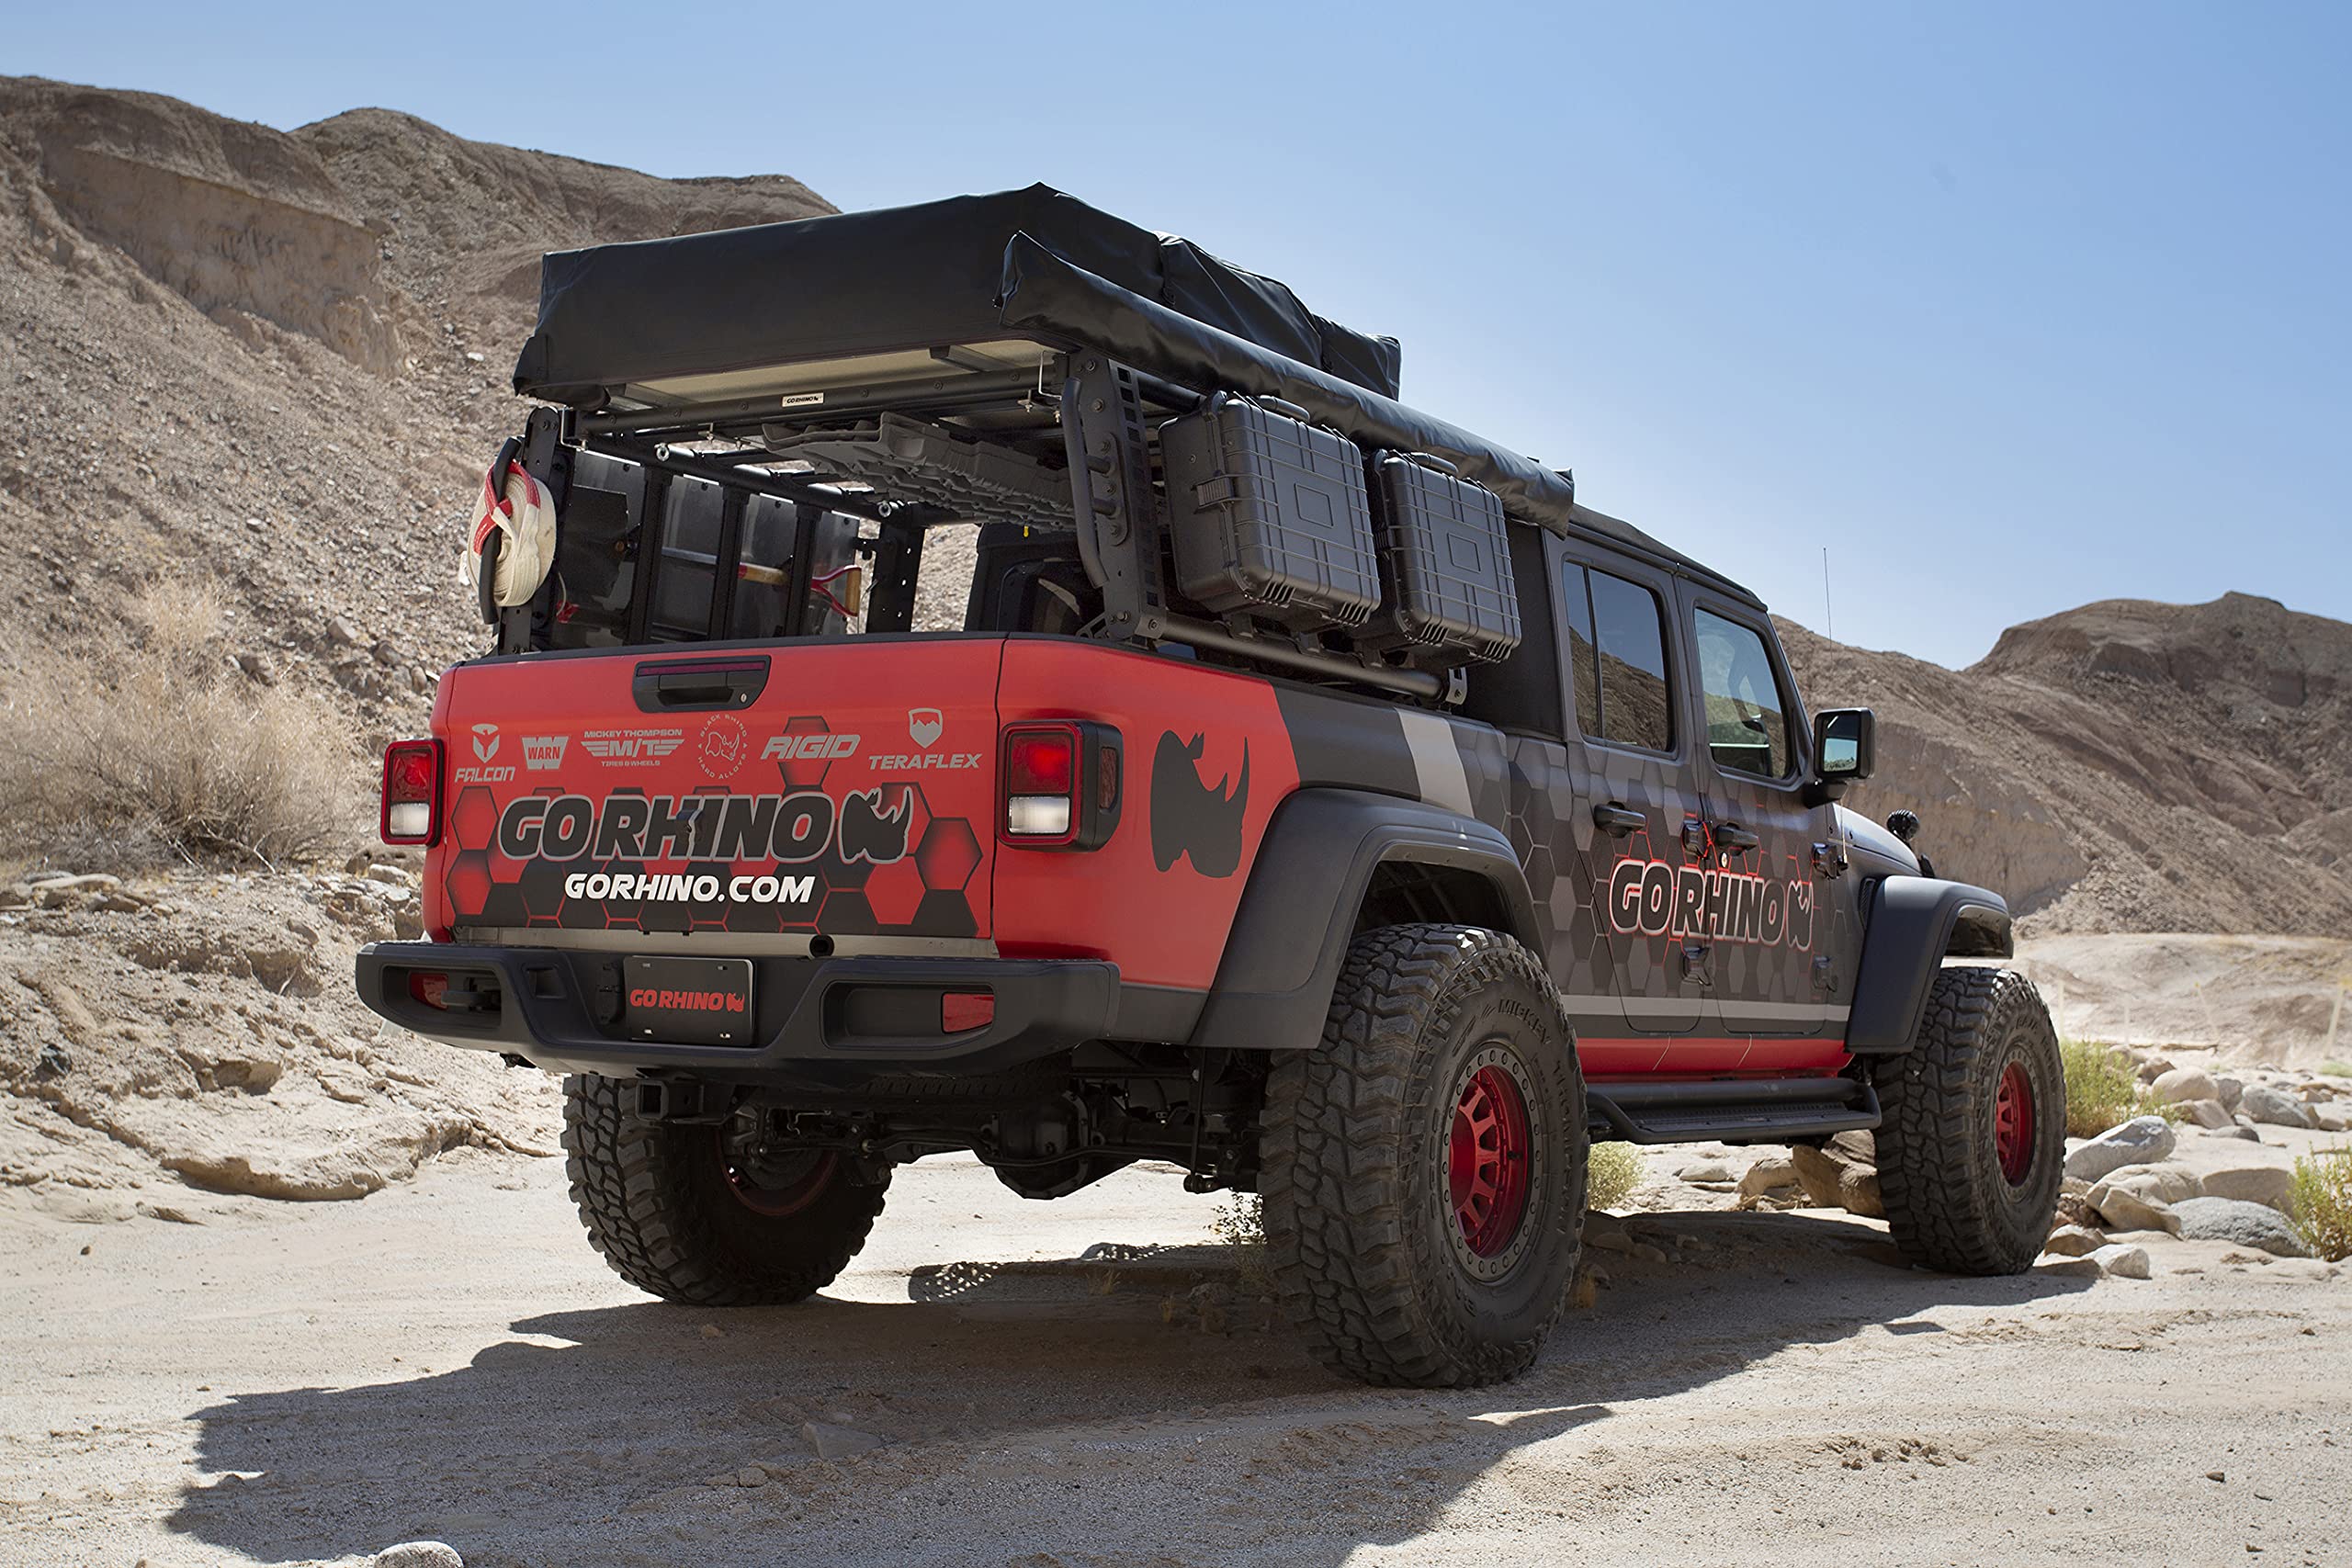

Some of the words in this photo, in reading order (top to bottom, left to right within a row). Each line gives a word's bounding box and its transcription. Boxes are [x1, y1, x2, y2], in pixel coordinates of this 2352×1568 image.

[584, 730, 622, 739] MICKEY
[624, 728, 683, 738] THOMPSON
[700, 714, 720, 738] BLACK
[725, 714, 747, 738] RHINO
[760, 734, 861, 760] RIGID
[698, 754, 716, 778] HARD
[718, 753, 746, 780] ALLOYS
[868, 753, 983, 771] TERAFLEX
[454, 766, 515, 783] FALCON
[564, 874, 816, 903] GORHINO.COM
[629, 988, 658, 1008] GO
[658, 990, 725, 1011] RHINO
[1498, 998, 1552, 1045] MICKEY
